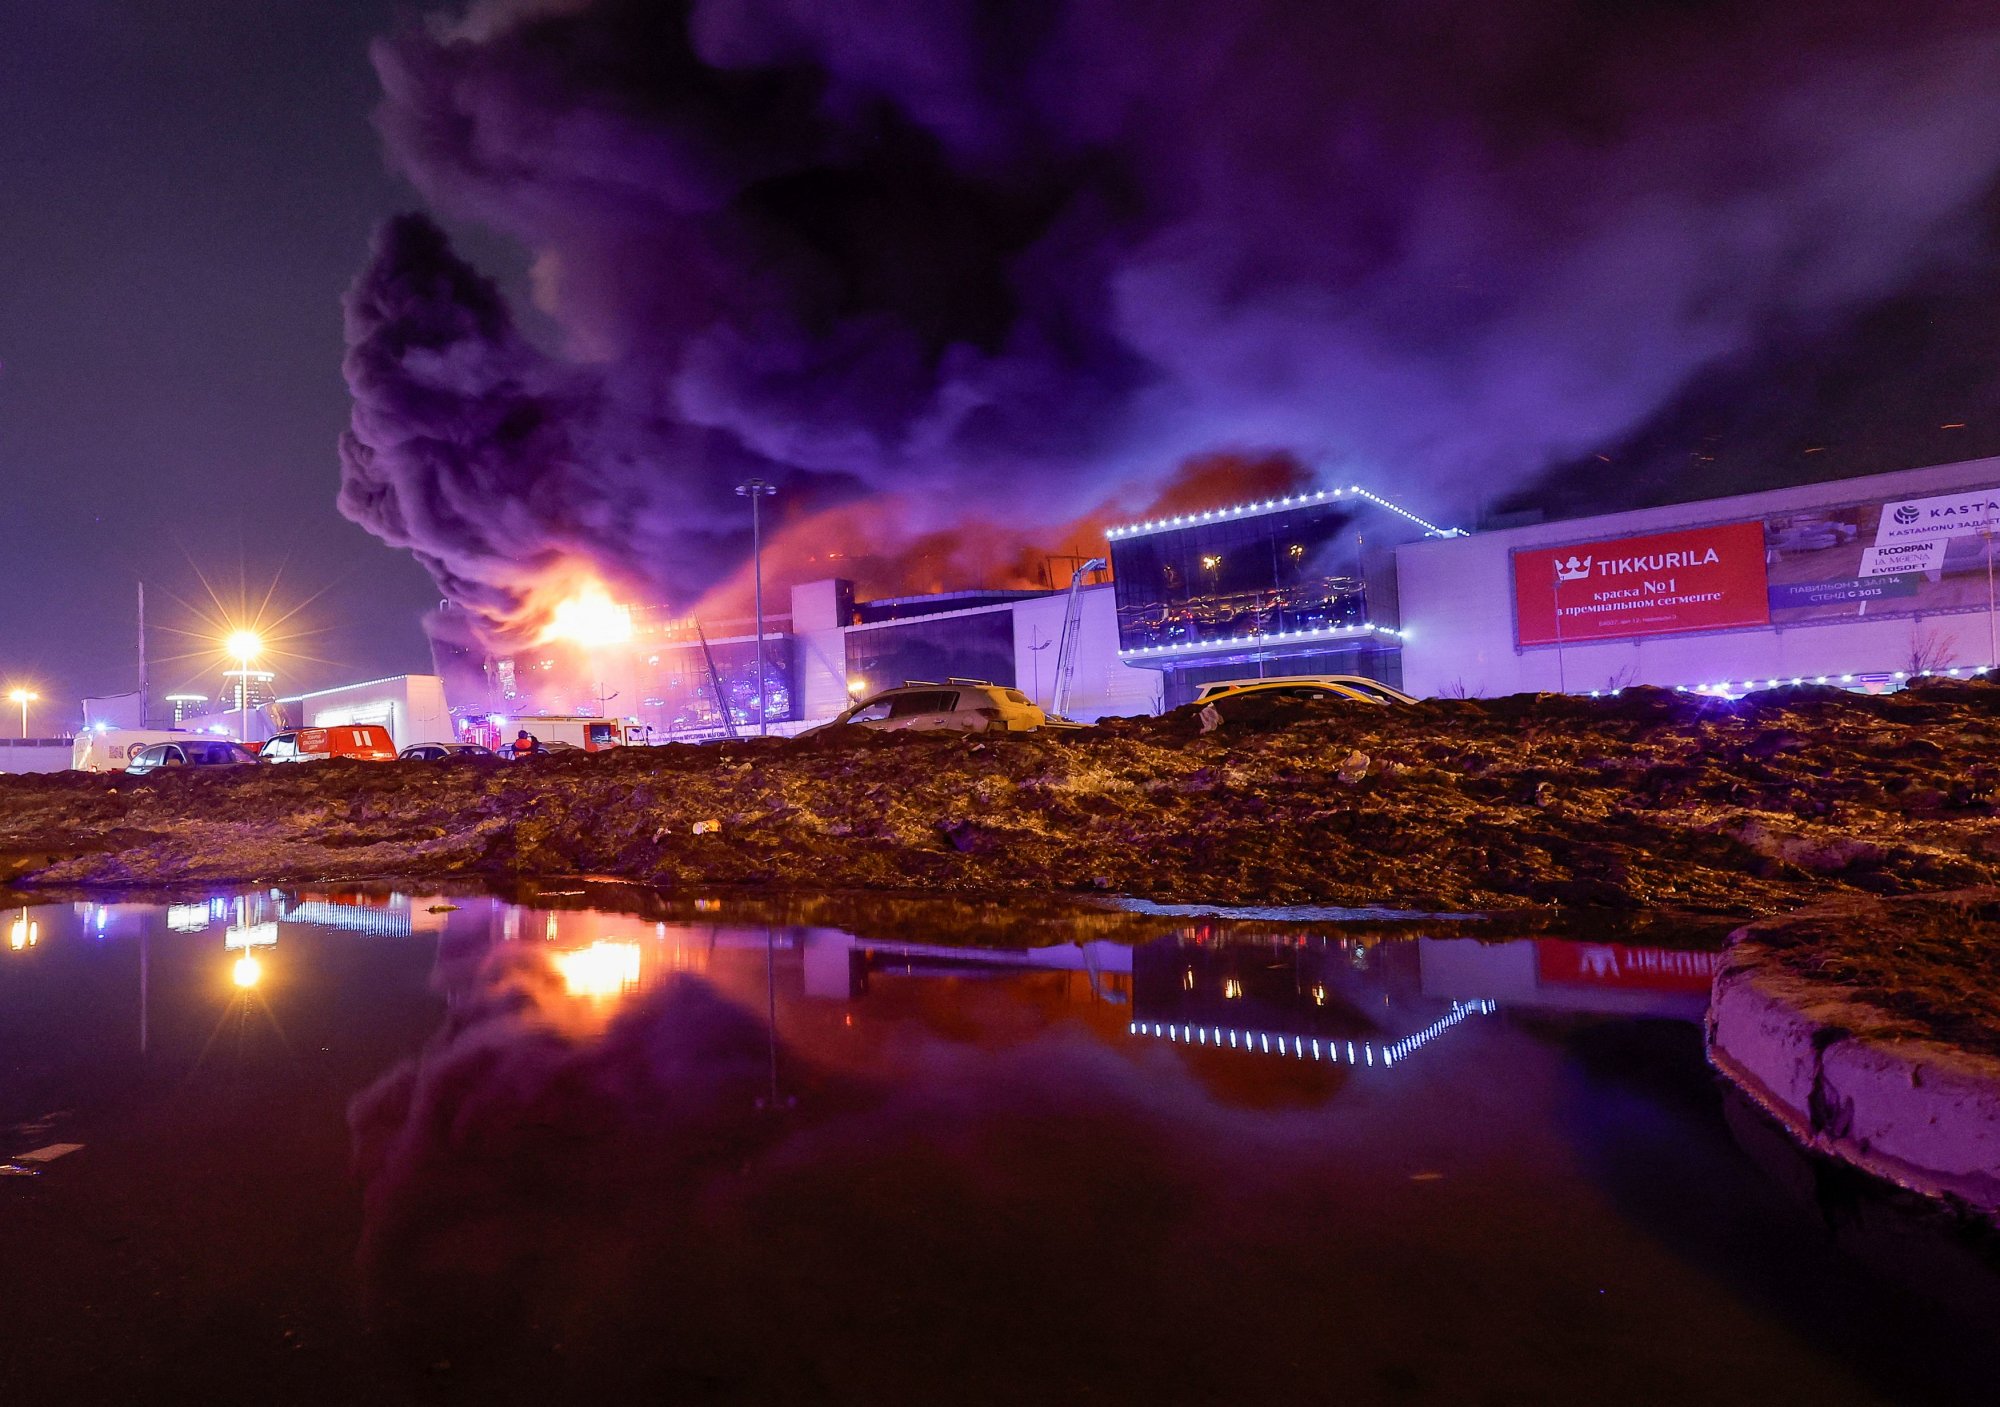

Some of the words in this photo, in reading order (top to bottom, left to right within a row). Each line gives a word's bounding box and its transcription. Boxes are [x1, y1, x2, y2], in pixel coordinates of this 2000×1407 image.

[1930, 502, 2000, 517] KASTA
[1888, 524, 1954, 537] KASTAMONU
[1878, 543, 1933, 556] FLOORPAN
[1597, 548, 1719, 576] TIKKURILA
[1871, 563, 1927, 574] EVOSOFT
[1789, 582, 1850, 594] ПАВИЛЬОН
[1863, 578, 1886, 587] ЗАЛ
[1593, 588, 1640, 601] краска
[1810, 592, 1846, 602] СТЕНД
[1858, 588, 1882, 597] 3013
[1565, 600, 1654, 617] премиальном
